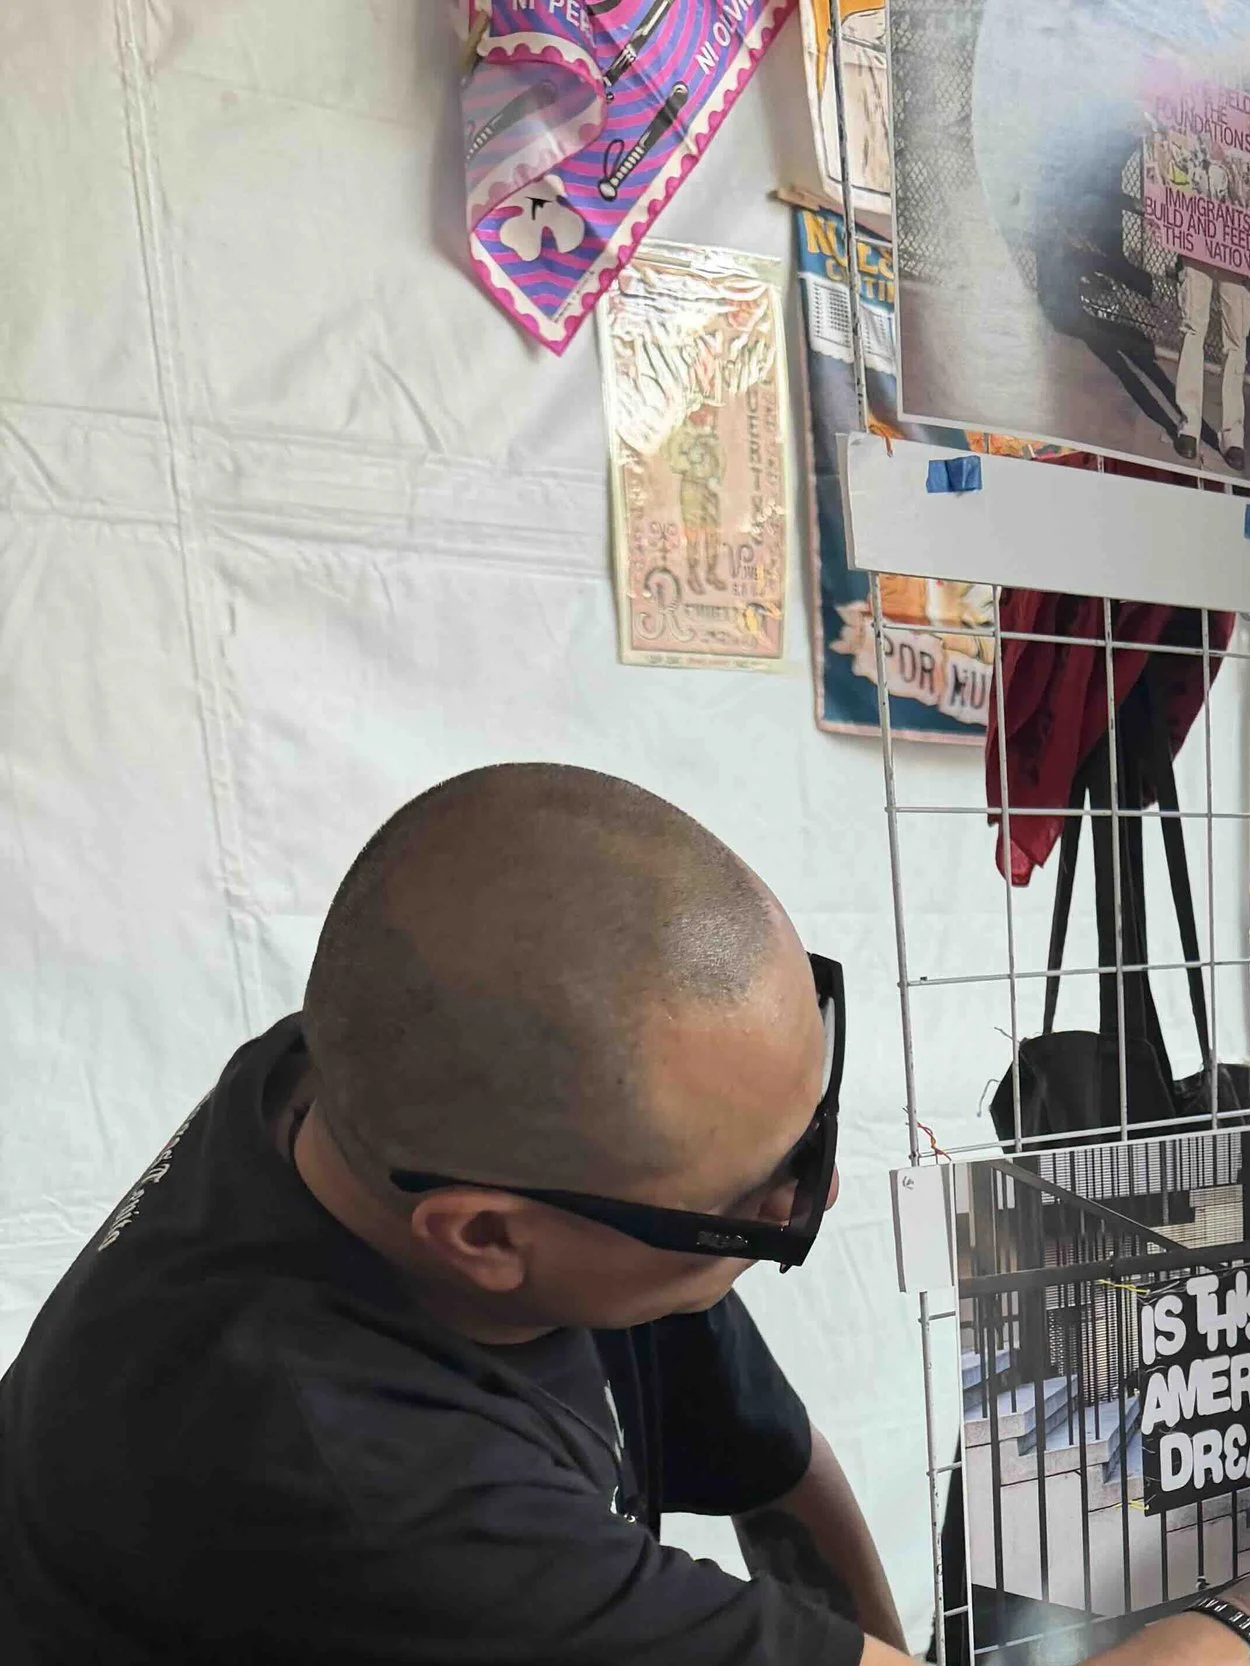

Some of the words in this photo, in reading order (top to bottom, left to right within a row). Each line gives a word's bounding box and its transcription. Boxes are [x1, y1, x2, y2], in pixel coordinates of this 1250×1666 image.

[694, 44, 720, 76] NI
[1146, 197, 1185, 229] BUILD
[1187, 216, 1218, 239] AND
[1163, 224, 1195, 252] THIS
[1141, 1293, 1187, 1365] IS
